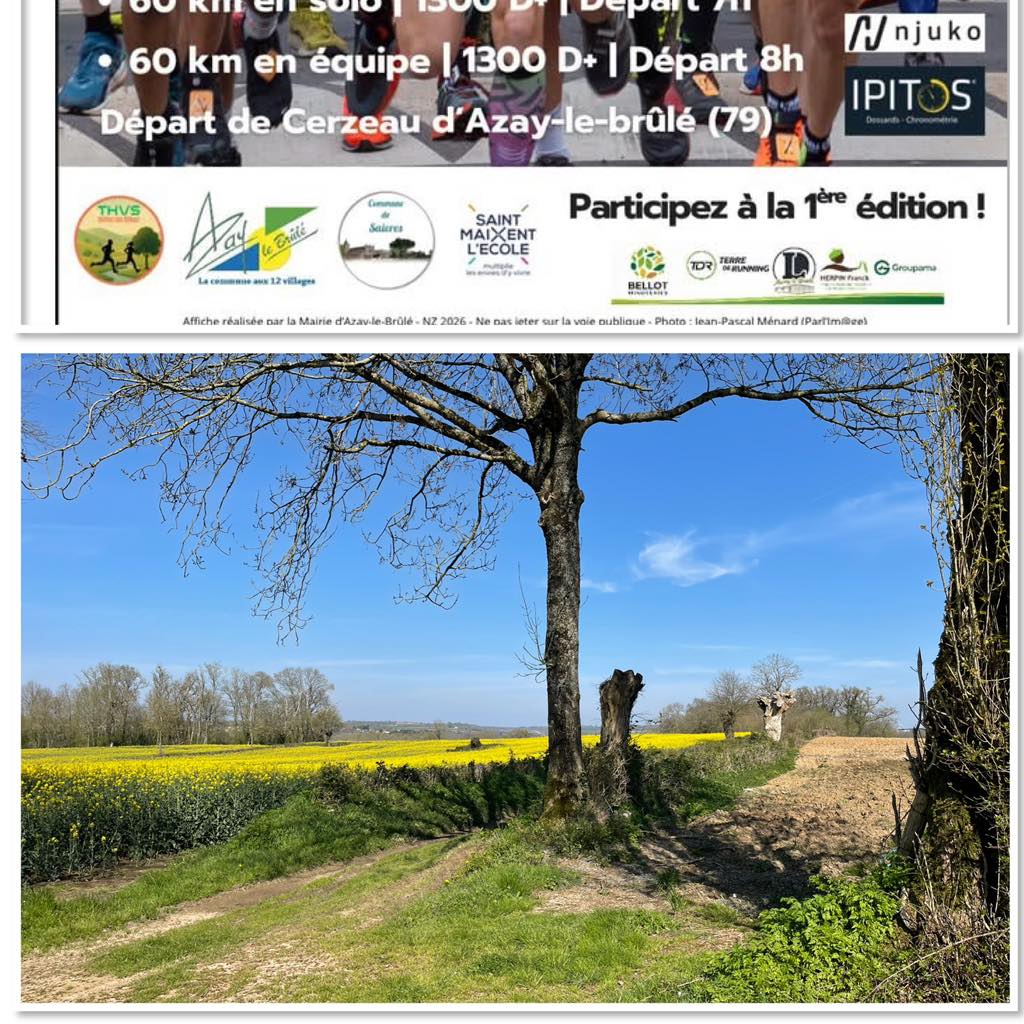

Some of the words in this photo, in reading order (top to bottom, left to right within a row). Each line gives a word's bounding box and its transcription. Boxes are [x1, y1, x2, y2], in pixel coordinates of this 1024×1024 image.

[895, 20, 981, 46] njuko
[129, 47, 176, 74] 60
[188, 45, 242, 73] km
[253, 52, 297, 74] en
[310, 46, 431, 81] équipe
[462, 46, 546, 73] 1300
[558, 46, 598, 73] D+
[629, 45, 748, 81] Départ
[760, 44, 804, 73] 8h
[101, 108, 217, 141] Départ
[227, 108, 271, 135] de
[282, 108, 420, 135] Cerzeau
[432, 106, 696, 140] d'Azay-le-brûlé
[708, 106, 773, 139] (79)
[98, 205, 142, 217] THVS
[569, 193, 728, 227] Participez
[738, 193, 758, 219] à
[767, 192, 796, 219] la
[804, 188, 848, 219] 1ère
[856, 192, 969, 219] édition
[977, 193, 986, 219] !
[475, 214, 522, 227] SAINT
[460, 227, 537, 242] MAIXENT
[467, 243, 530, 256] L'ECOLE
[690, 261, 714, 271] TDR
[719, 256, 748, 264] TERRE
[731, 265, 770, 273] RUNNING
[892, 263, 937, 273] Groupama
[628, 281, 669, 290] BELLOT
[182, 316, 220, 326] Affiche
[222, 316, 264, 326] réalisée
[287, 316, 297, 326] la
[299, 316, 333, 326] Mairie
[422, 316, 437, 326] NZ
[440, 316, 467, 326] 2026
[476, 316, 490, 326] Ne
[542, 318, 559, 326] sur
[562, 316, 571, 326] la
[573, 316, 596, 326] voie
[655, 316, 687, 326] Photo
[757, 316, 799, 326] Ménard
